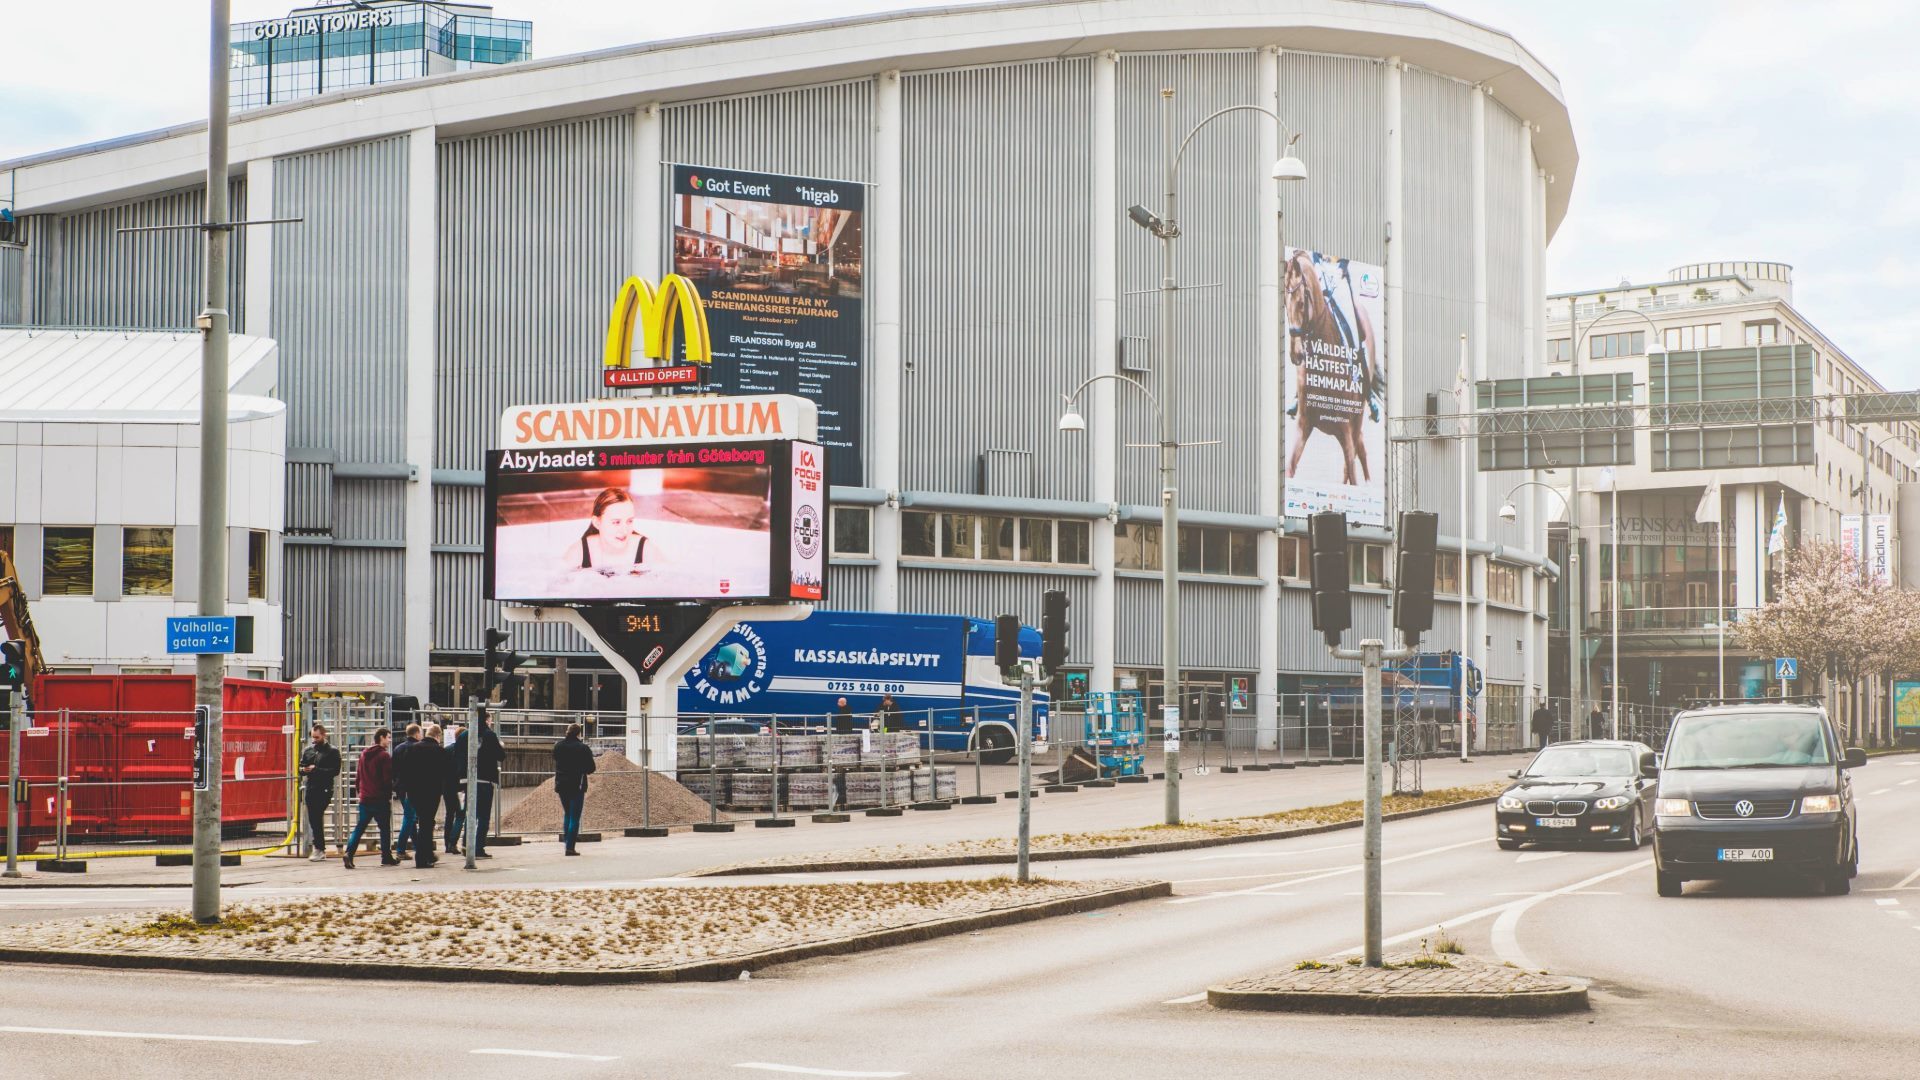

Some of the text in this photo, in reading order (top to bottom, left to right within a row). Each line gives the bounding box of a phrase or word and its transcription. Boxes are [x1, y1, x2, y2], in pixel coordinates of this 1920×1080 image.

[254, 10, 392, 40] GOTHIA TOWERS
[706, 178, 771, 197] Got Event
[712, 290, 790, 305] SCANDINAVIUM
[815, 299, 829, 308] NY
[702, 299, 839, 318] EVENEMANGSRESTAURANG
[730, 335, 817, 349] ERLANDSSON Bygg AB
[1311, 338, 1358, 361] VÄRLDENS
[1306, 354, 1349, 376] HÄSTFEST
[620, 368, 693, 382] ALLTID ÖPPET
[1306, 373, 1363, 394] HEMMAPLAN
[516, 401, 783, 443] SCANDINAVIUM
[500, 447, 765, 472] Åbybadet 3 minuter från Göteborg
[801, 450, 815, 468] ICA
[795, 468, 821, 481] FOCUS
[795, 526, 819, 538] FOCUS
[1875, 525, 1886, 575] stadium
[173, 621, 229, 633] Valhalla-
[627, 615, 661, 632] 9:41
[173, 635, 229, 650] gatan 2-4
[794, 648, 941, 667] KASSASKÅPSFLYTT
[828, 681, 905, 693] 0725 240 800
[1724, 849, 1771, 859] EEP 400
